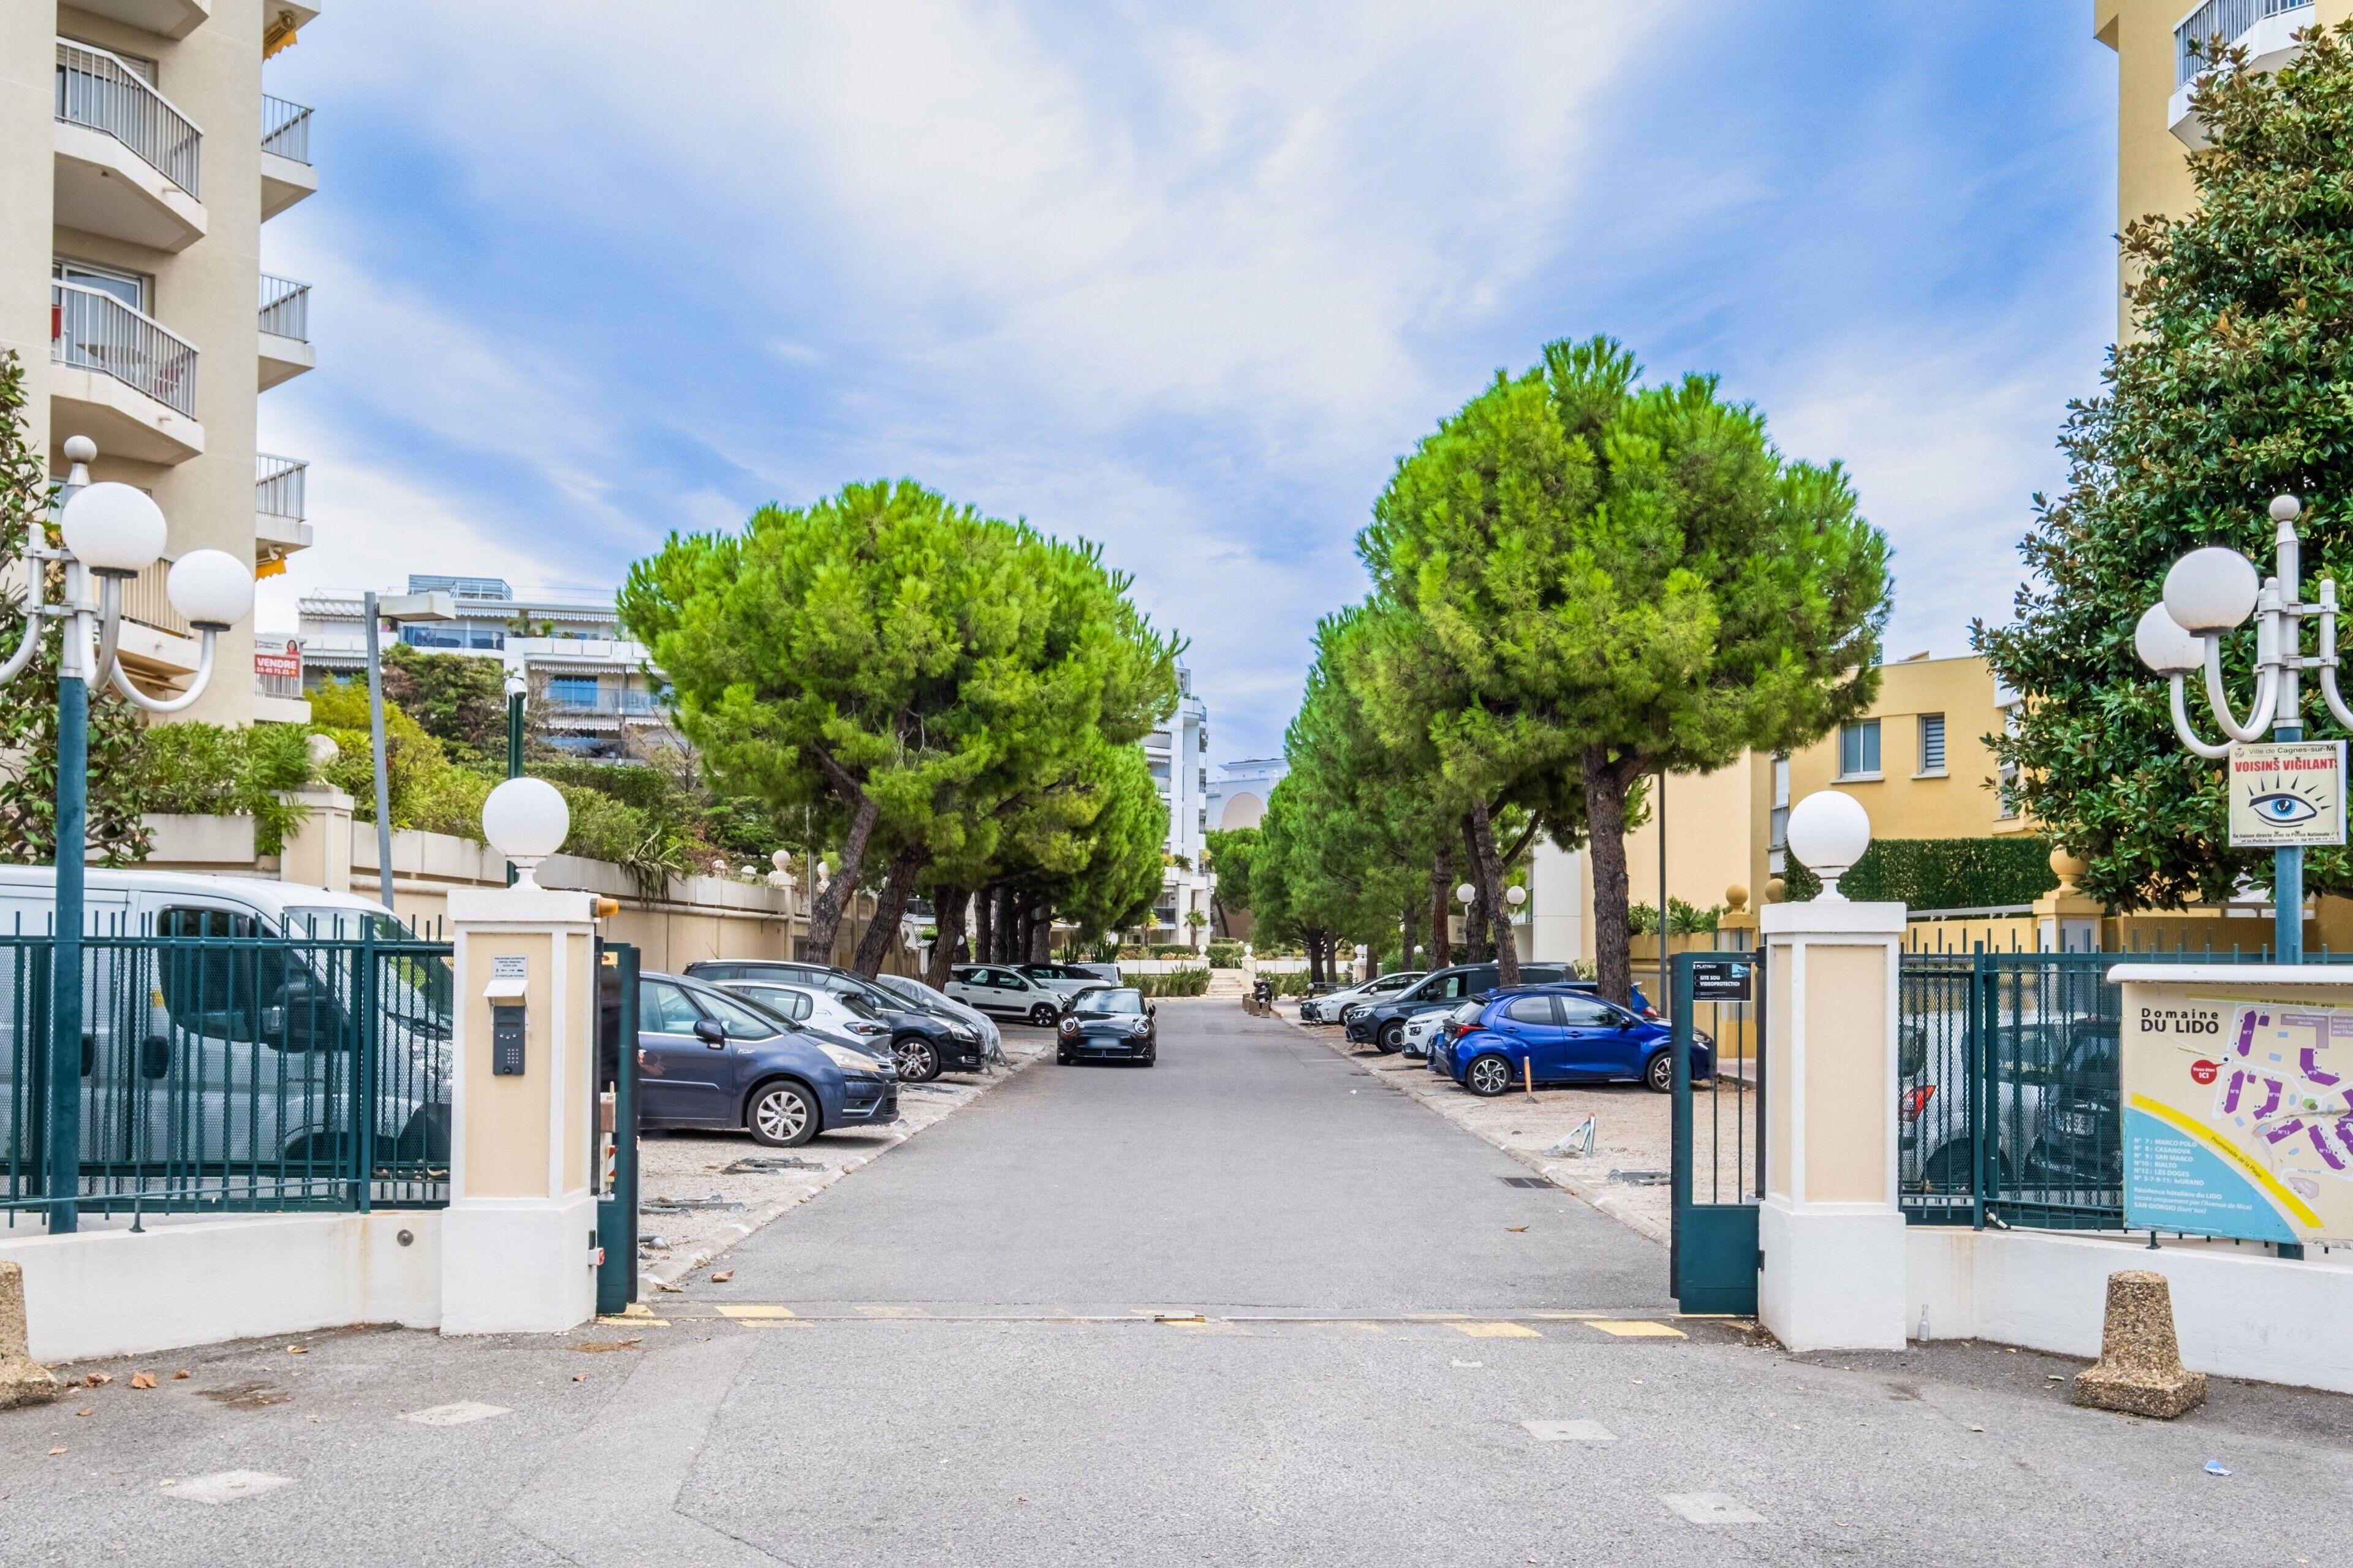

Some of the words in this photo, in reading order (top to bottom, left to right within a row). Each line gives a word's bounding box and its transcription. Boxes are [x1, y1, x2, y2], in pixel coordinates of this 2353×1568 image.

[257, 657, 297, 669] VENDRE
[2235, 760, 2280, 772] VOISINS
[2141, 1008, 2219, 1019] Domaine
[2141, 1019, 2166, 1032] DU
[2175, 1020, 2219, 1034] LIDO
[2211, 1136, 2238, 1158] Promenade
[2249, 1165, 2262, 1178] Plage
[2166, 1189, 2195, 1197] hôtelière
[2153, 1197, 2188, 1205] uniquement
